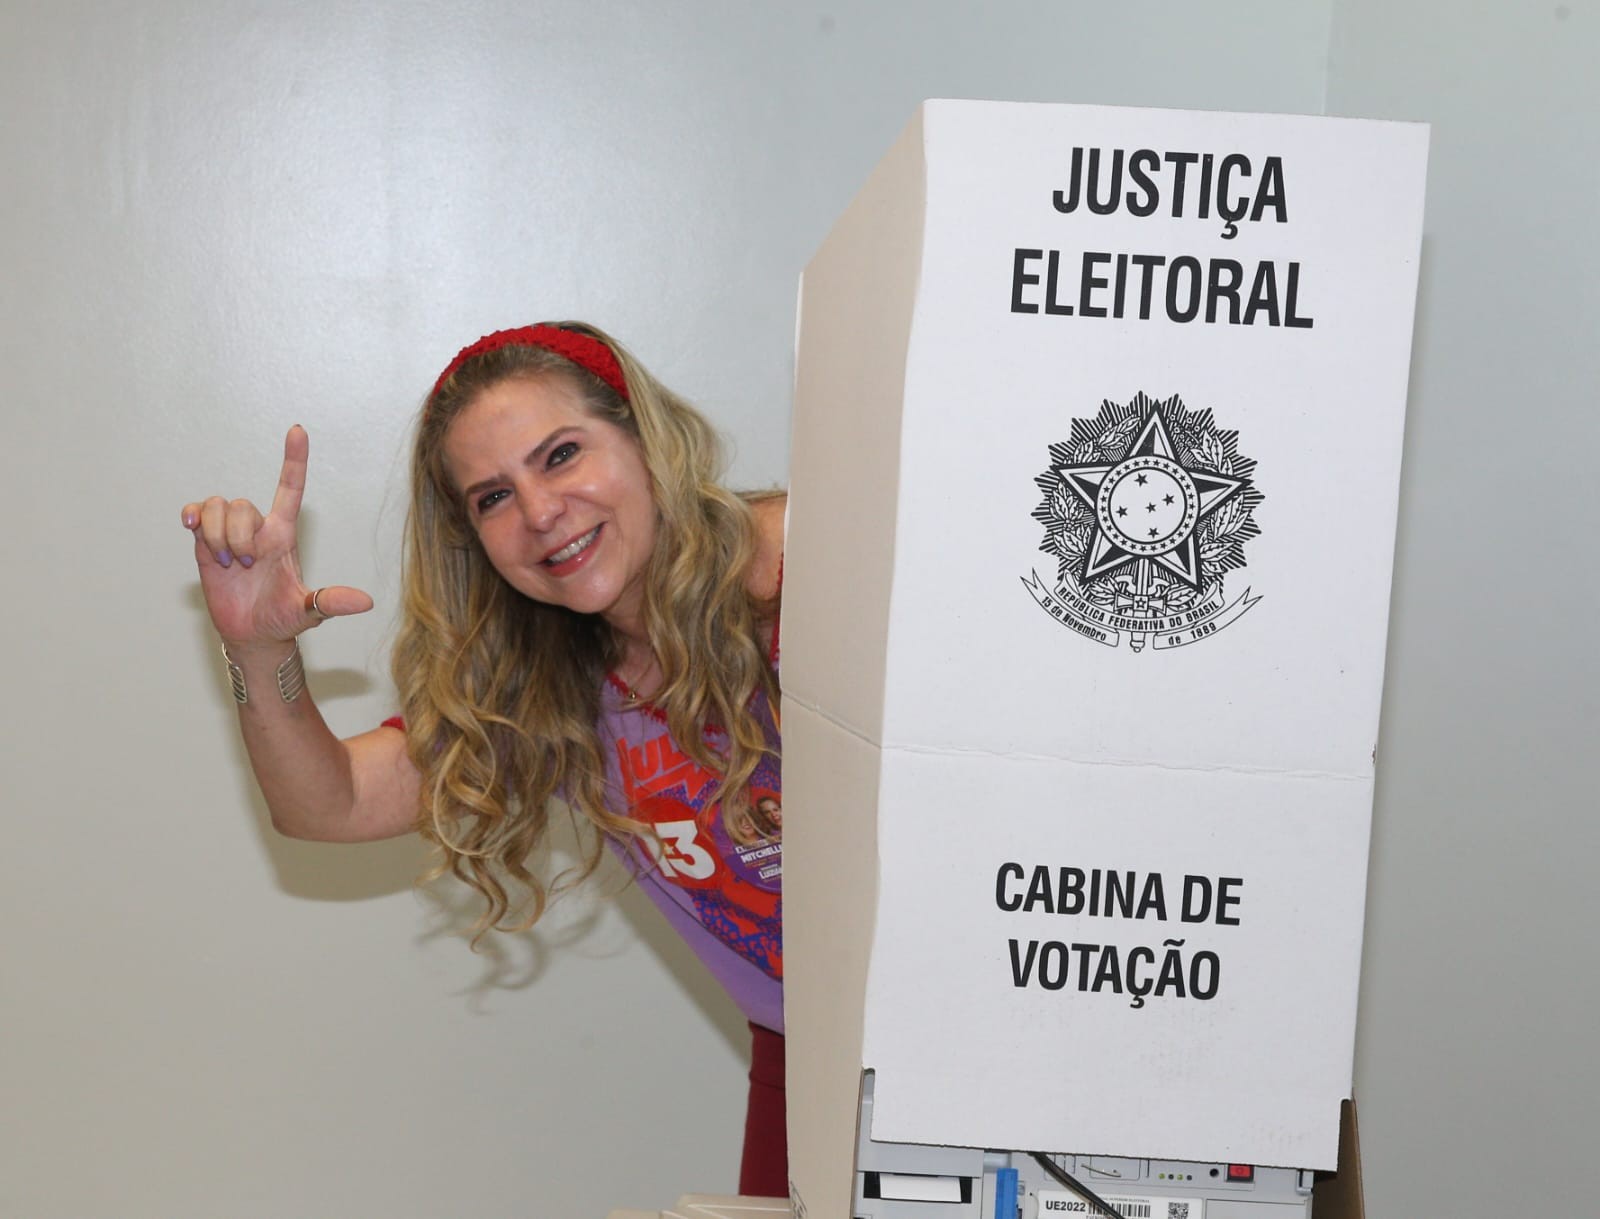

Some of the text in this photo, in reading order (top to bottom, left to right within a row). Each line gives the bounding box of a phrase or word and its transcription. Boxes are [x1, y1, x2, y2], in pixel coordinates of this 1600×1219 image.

[1053, 148, 1287, 239] JUSTIÇA
[1011, 249, 1313, 328] ELEITORAL
[1041, 596, 1107, 641] 15 de Novembro
[1058, 587, 1219, 630] REPÚBLICA FEDERATIVA DO BRASIL
[1168, 622, 1216, 645] de 1889
[641, 819, 716, 880] 13
[996, 863, 1243, 925] CABINA DE
[1009, 939, 1220, 1008] VOTAÇÃO
[1045, 1200, 1087, 1212] UE2022
